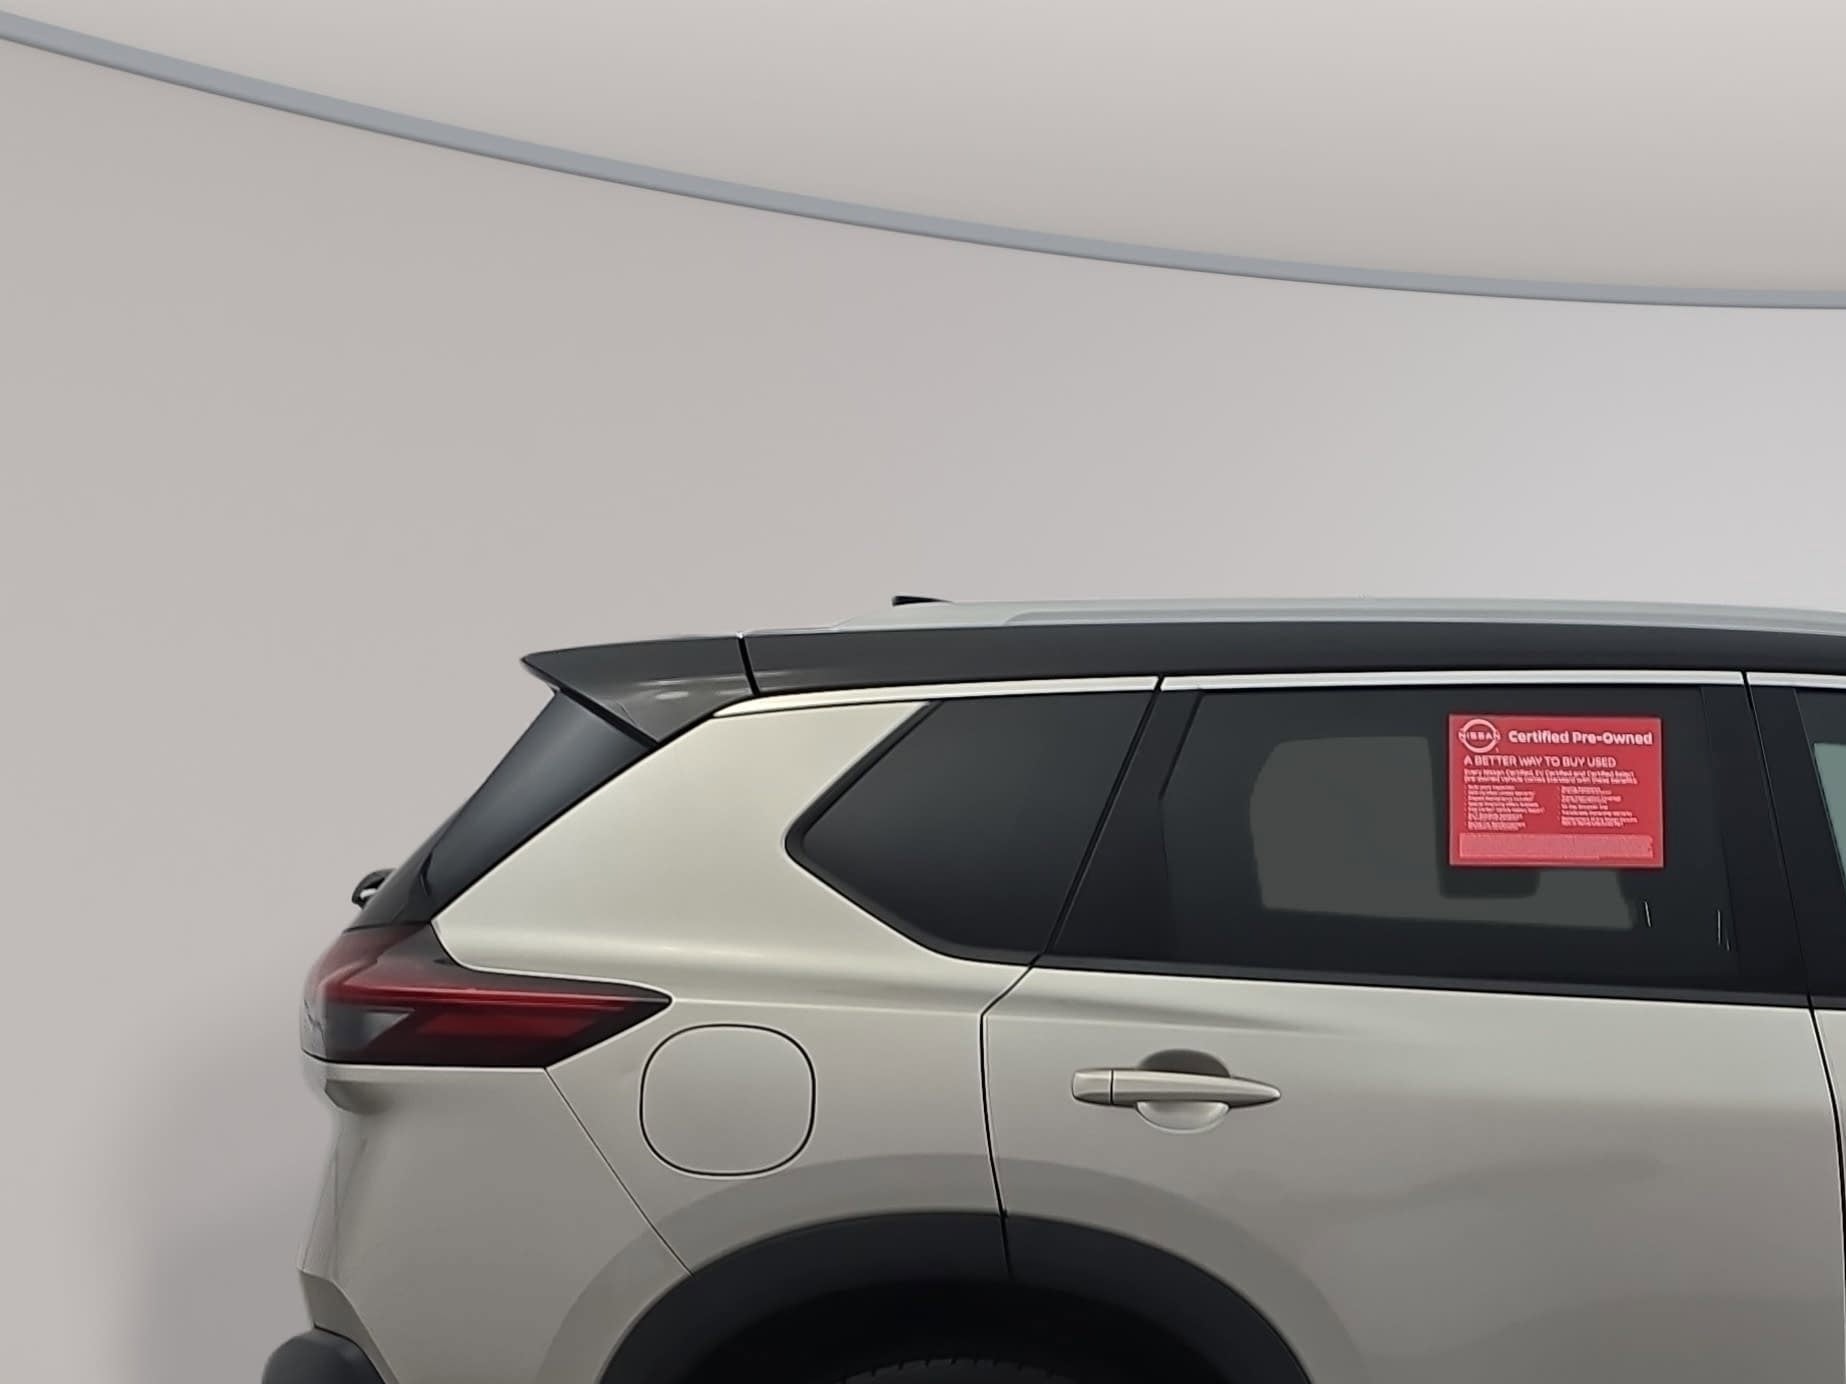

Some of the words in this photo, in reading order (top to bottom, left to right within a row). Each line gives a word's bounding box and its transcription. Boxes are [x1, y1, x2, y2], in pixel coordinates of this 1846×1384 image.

[1508, 729, 1569, 744] Certified
[1572, 731, 1653, 746] Pre-Owned
[1463, 755, 1473, 767] A
[1474, 754, 1518, 767] BETTER
[1519, 755, 1543, 767] WAY
[1544, 756, 1560, 768] TO
[1562, 756, 1585, 768] BUY
[1587, 757, 1616, 769] USED
